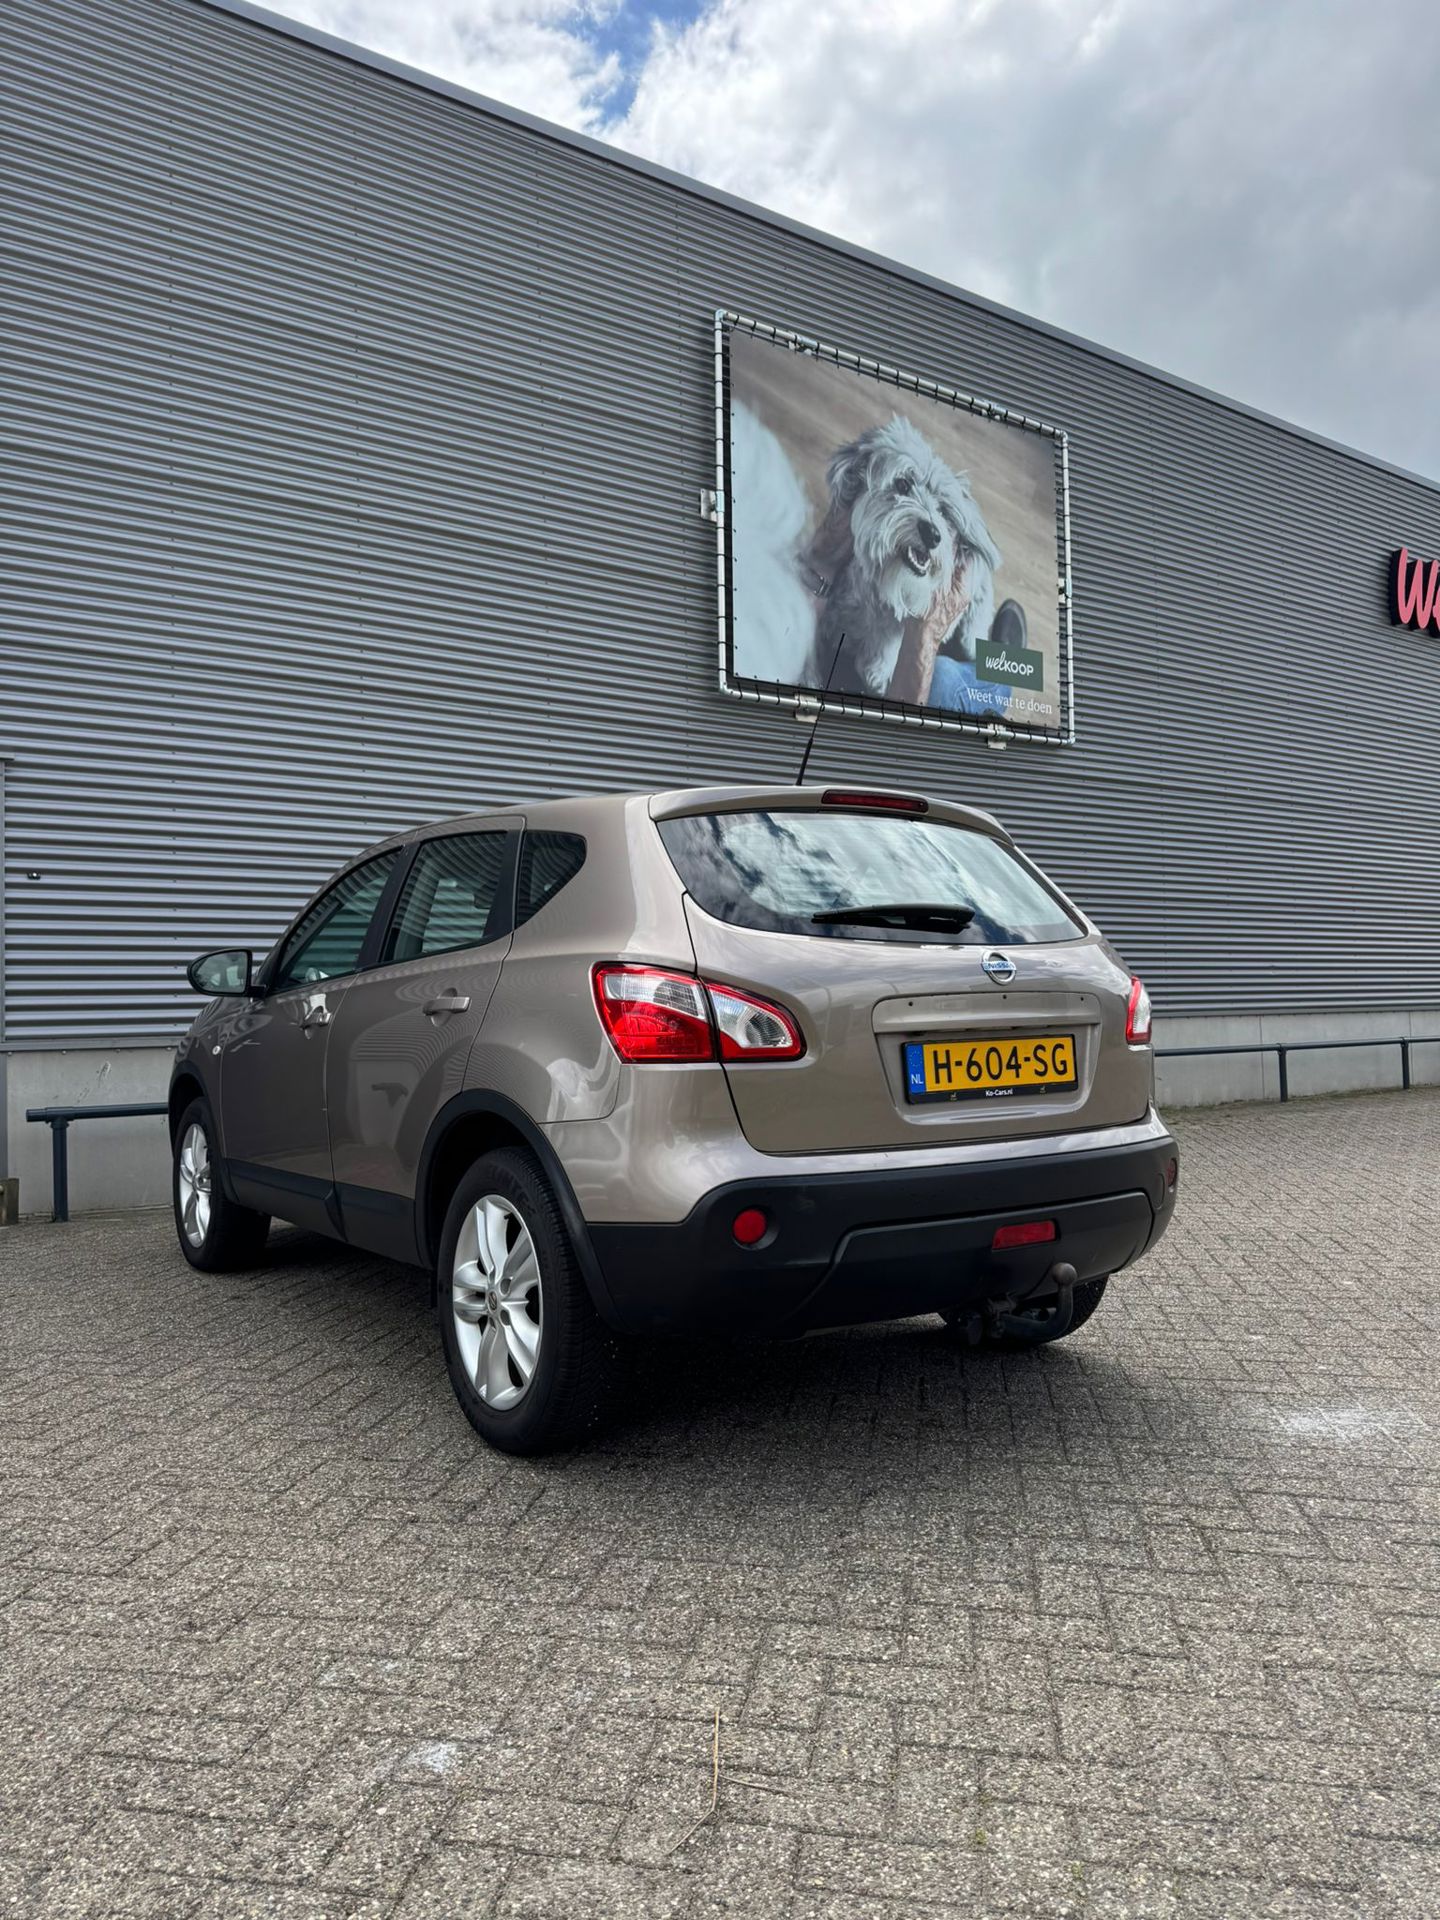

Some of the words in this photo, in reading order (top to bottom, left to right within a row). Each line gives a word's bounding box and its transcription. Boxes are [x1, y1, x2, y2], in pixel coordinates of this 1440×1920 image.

[1398, 546, 1440, 633] W
[967, 687, 993, 704] Weet
[995, 694, 1013, 708] wat
[1015, 698, 1026, 709] te
[1027, 698, 1052, 714] doen
[933, 1043, 1068, 1084] H-604-SG
[911, 1073, 924, 1085] NL
[985, 1088, 1013, 1097] Ko-Cars.nl
